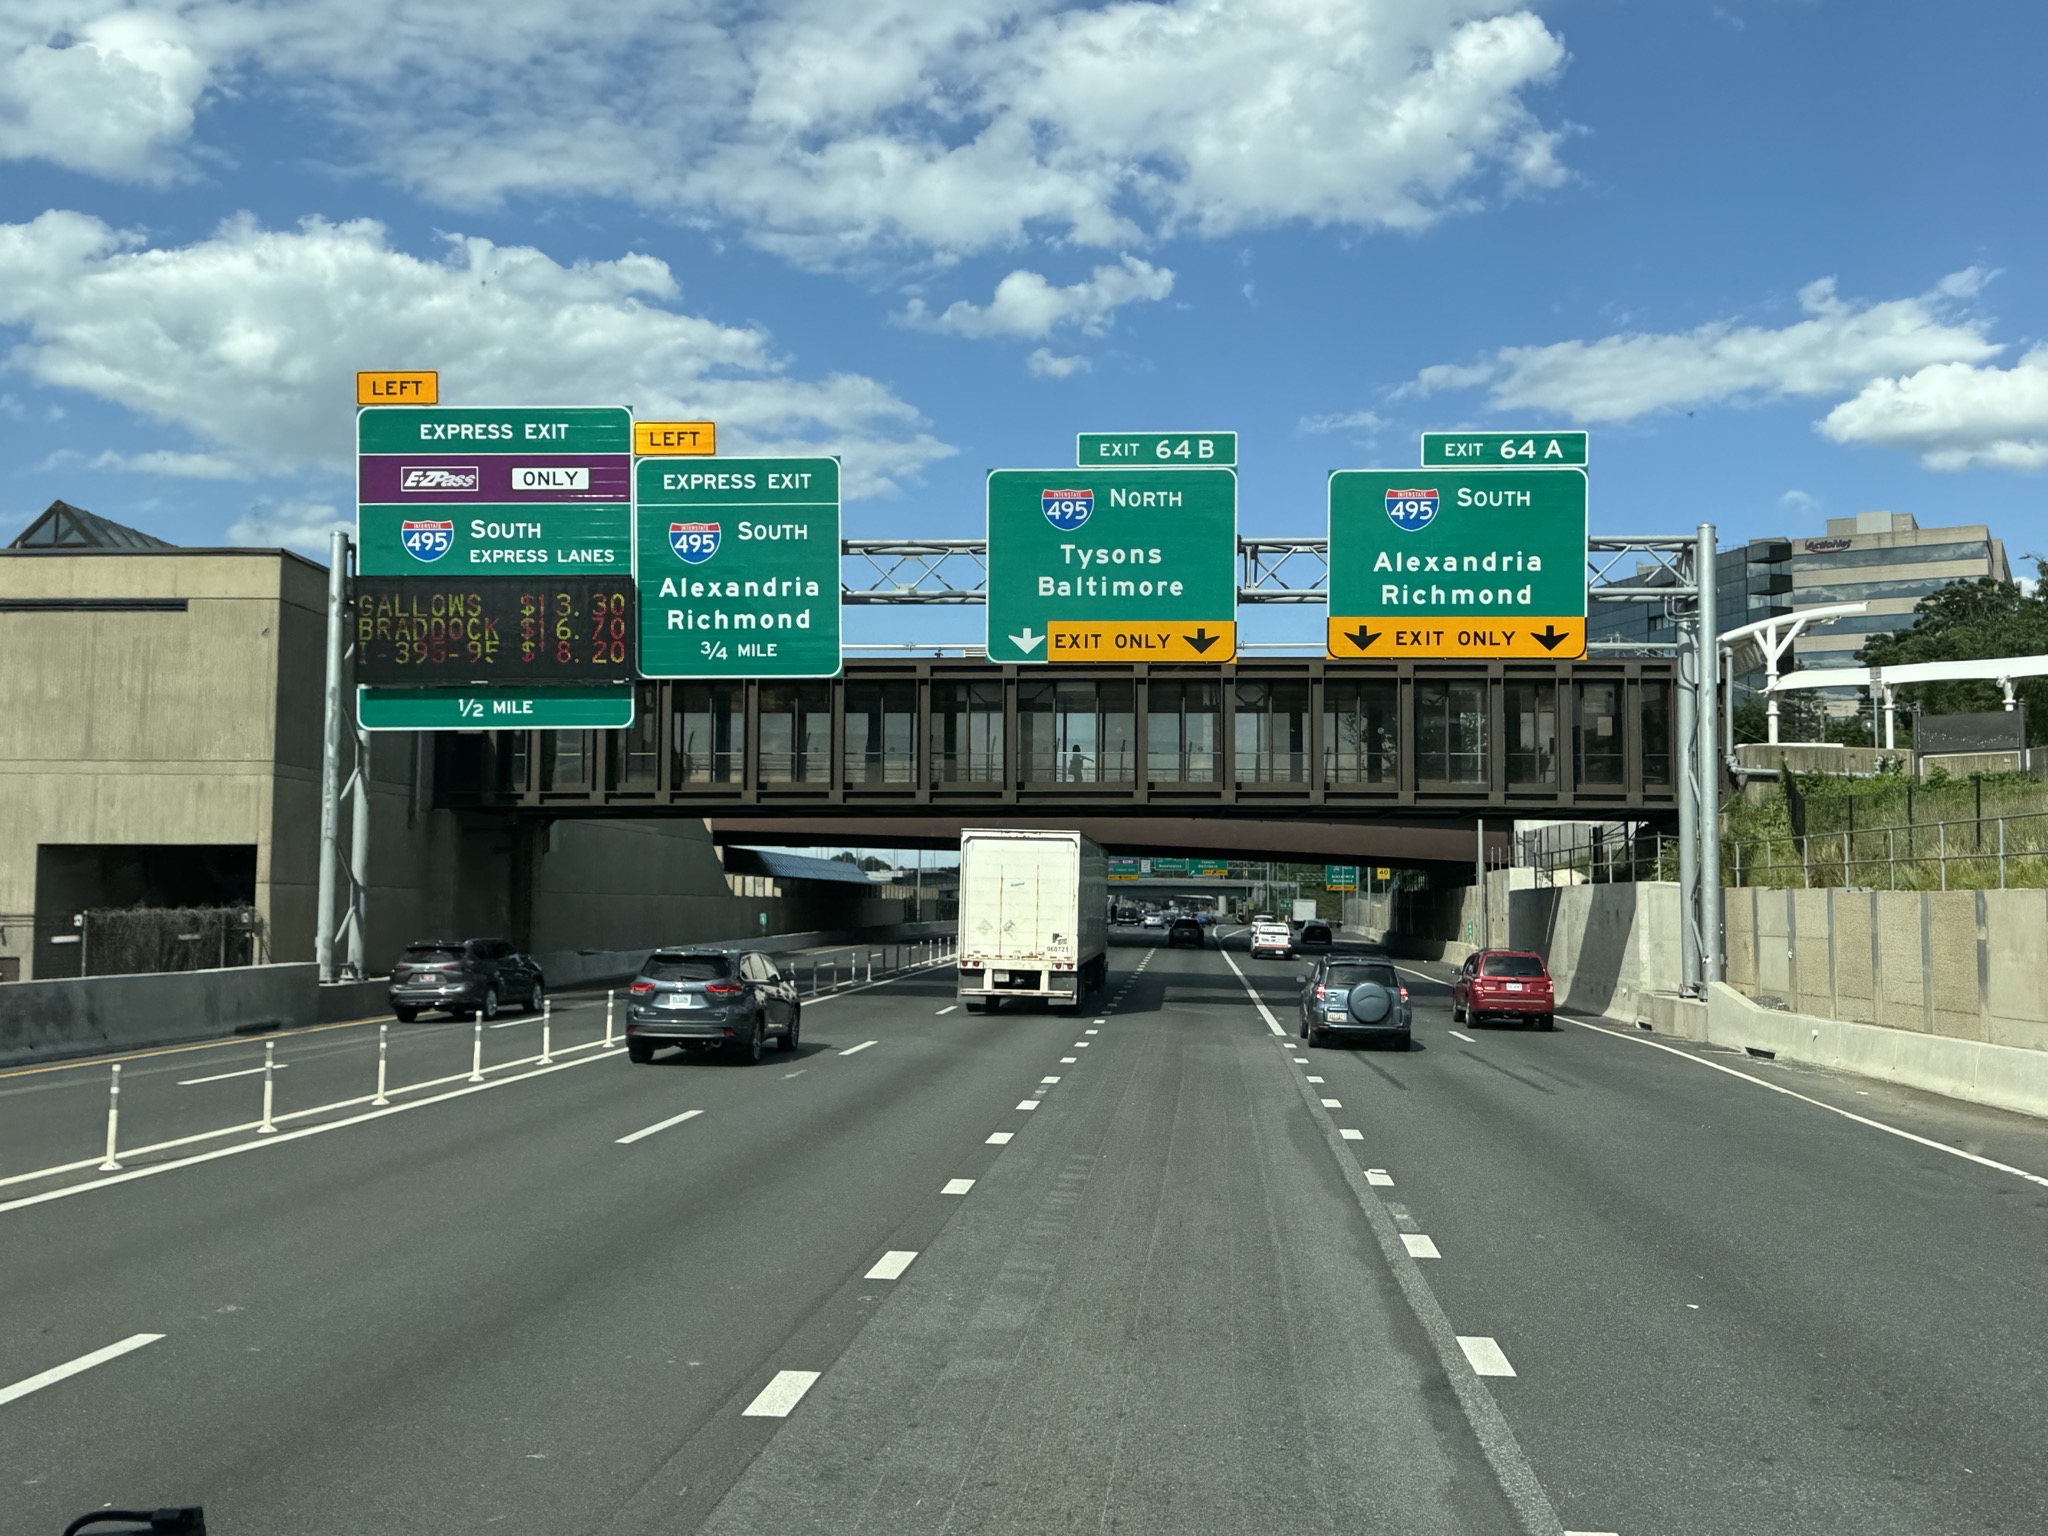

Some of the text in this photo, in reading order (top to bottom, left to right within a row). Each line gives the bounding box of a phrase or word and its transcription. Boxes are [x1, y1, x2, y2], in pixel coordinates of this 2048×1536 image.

[372, 380, 423, 396] LEFT
[420, 423, 569, 440] EXPRESS EXIT
[649, 431, 700, 447] LEFT
[1099, 443, 1140, 457] EXIT
[1445, 442, 1484, 457] EXIT
[523, 471, 579, 487] ONLY
[663, 473, 812, 490] EXPRESS EXIT
[1046, 500, 1088, 519] 495
[1390, 500, 1433, 519] 495
[407, 532, 448, 551] 495
[674, 533, 715, 553] 495
[470, 549, 615, 563] EXPRESS LANES
[1060, 544, 1162, 570] Tysons
[1373, 550, 1542, 572] Alexandria
[658, 576, 819, 598] Alexandria
[1038, 575, 1184, 597] Baltimore
[1381, 584, 1531, 605] Richmond
[358, 594, 482, 617] GALLOWS
[667, 608, 810, 630] Richmond
[358, 618, 499, 641] BRADDOCK
[1395, 630, 1516, 646] EXIT ONLY
[737, 643, 778, 657] MILE
[1054, 633, 1171, 649] EXIT ONLY
[493, 700, 534, 714] MILE
